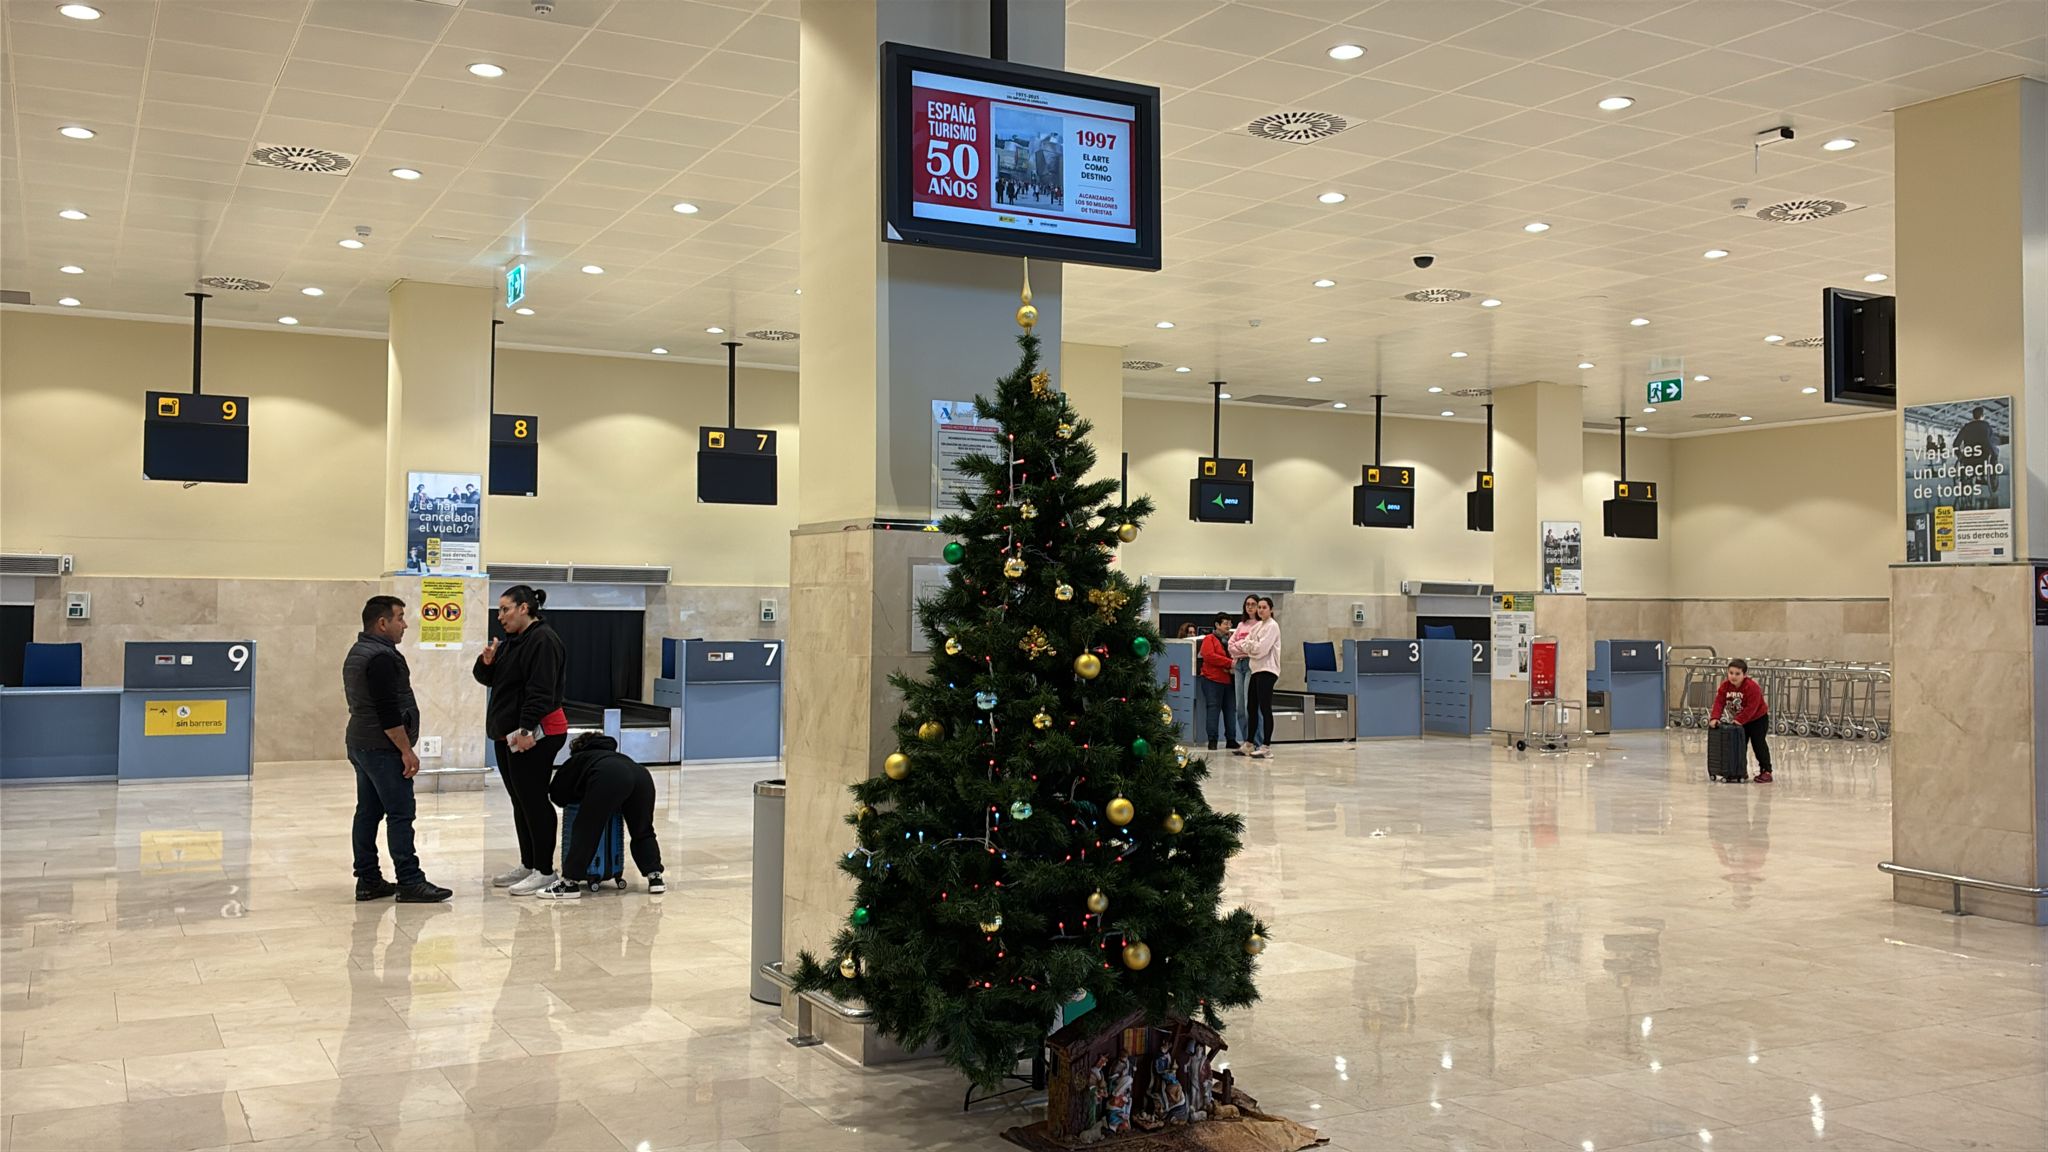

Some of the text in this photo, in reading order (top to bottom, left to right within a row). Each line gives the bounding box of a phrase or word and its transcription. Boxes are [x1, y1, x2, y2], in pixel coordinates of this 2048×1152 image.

[927, 100, 976, 125] ESPAÑA
[928, 120, 977, 142] TURISMO
[1076, 129, 1117, 151] 1997
[926, 139, 979, 180] 50
[1083, 153, 1110, 164] EL ARTE
[1081, 171, 1112, 182] DESTINO
[1084, 163, 1108, 173] COMO
[928, 176, 978, 200] AÑOS
[1079, 192, 1115, 202] ALCANZAMOS
[1093, 201, 1118, 210] MILLONES
[1089, 208, 1113, 216] TURISTAS
[222, 400, 238, 420] 9
[514, 419, 528, 438] 8
[756, 434, 768, 451] 7
[1913, 444, 1983, 463] Viajar es
[1237, 462, 1247, 478] 4
[1401, 470, 1409, 484] 3
[1913, 460, 2004, 480] un derecho
[1646, 485, 1652, 499] 1
[1913, 481, 1982, 499] de todos
[412, 500, 458, 513] ¿Le han
[419, 512, 474, 523] cancelado
[419, 523, 470, 534] el vuelo?
[1972, 530, 2009, 540] derechos
[227, 645, 249, 672] 9
[763, 644, 779, 666] 7
[1409, 642, 1420, 662] 3
[1473, 643, 1483, 662] 2
[1655, 643, 1661, 661] 1
[189, 719, 222, 727] barreras
